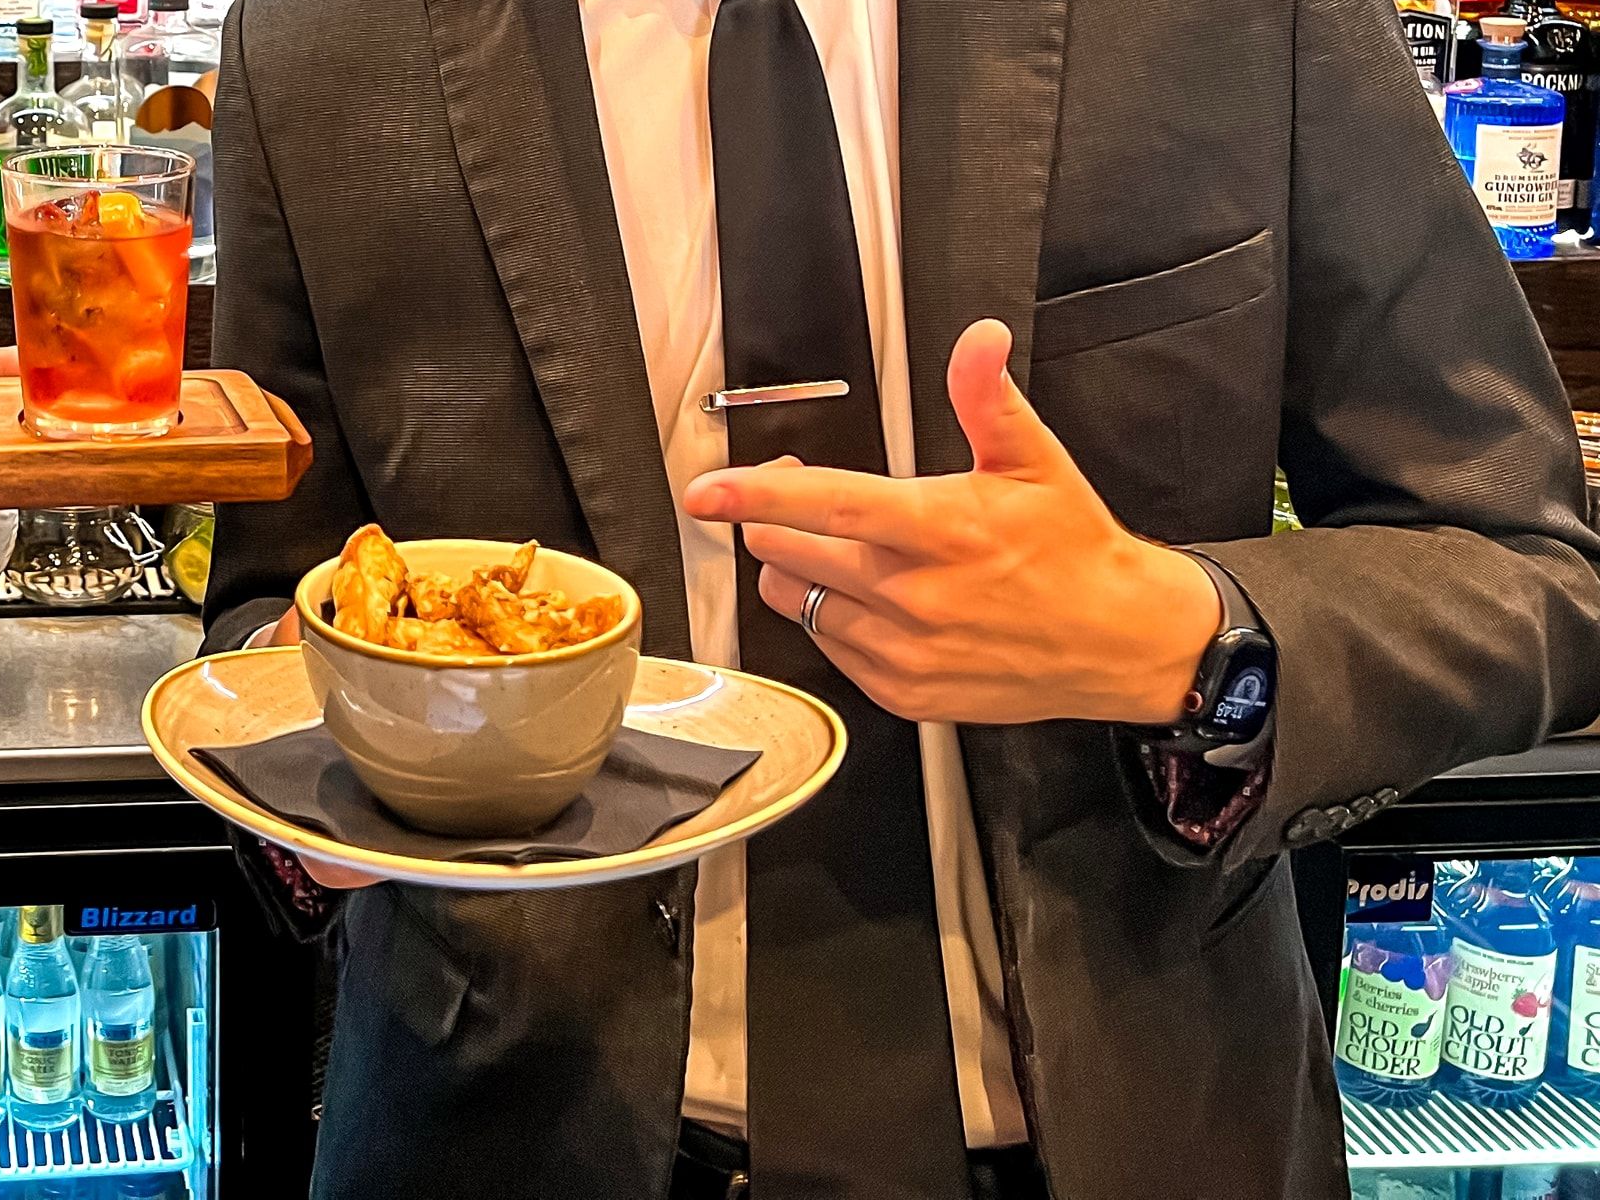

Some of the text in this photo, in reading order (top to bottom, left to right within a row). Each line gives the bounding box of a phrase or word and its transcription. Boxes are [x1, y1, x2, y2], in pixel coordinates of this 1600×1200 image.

[1404, 23, 1445, 40] TION
[1498, 193, 1535, 203] IRISH
[1538, 192, 1554, 203] GIN
[81, 904, 197, 928] Blizzard
[1354, 975, 1403, 1000] Berries
[1465, 974, 1500, 992] apple
[1366, 997, 1420, 1017] cherries
[1451, 1004, 1505, 1034] OLD
[1349, 1011, 1400, 1038] OLD
[1349, 1026, 1426, 1057] MOUT
[1450, 1020, 1534, 1056] MOUT
[1345, 1043, 1421, 1076] CIDER
[1445, 1040, 1528, 1077] CIDER
